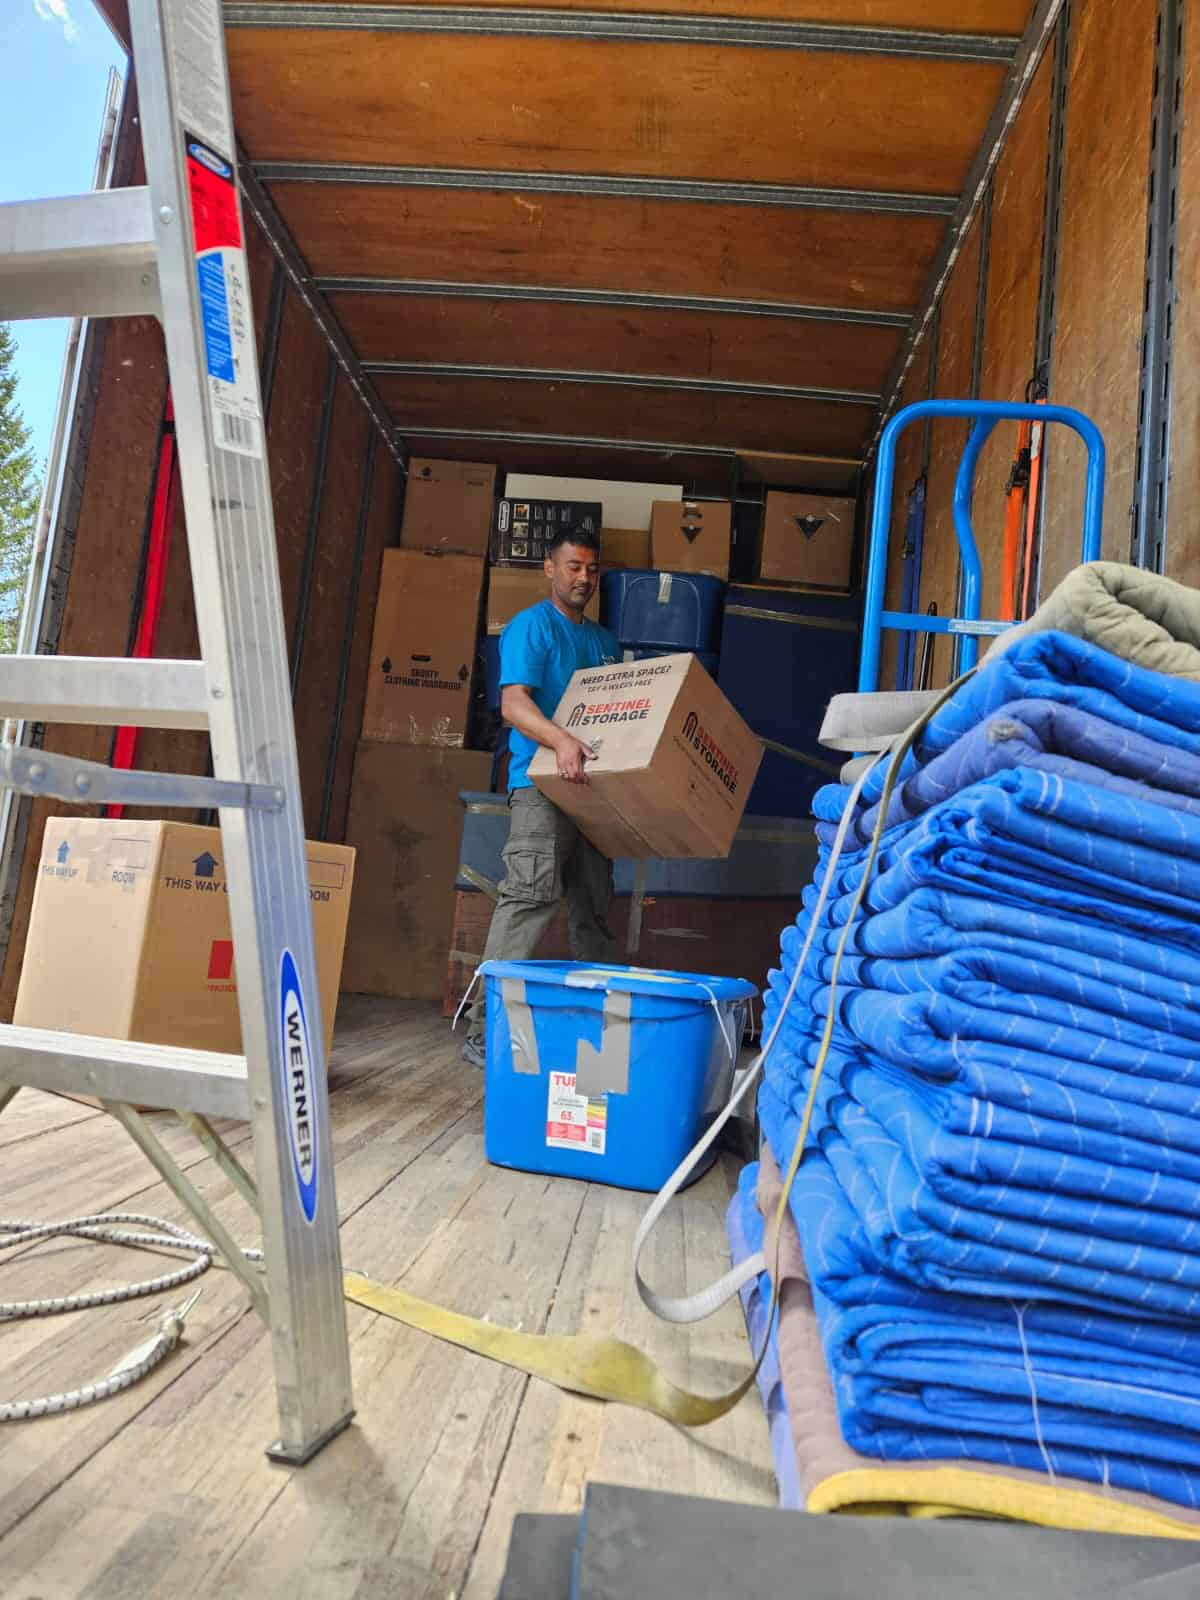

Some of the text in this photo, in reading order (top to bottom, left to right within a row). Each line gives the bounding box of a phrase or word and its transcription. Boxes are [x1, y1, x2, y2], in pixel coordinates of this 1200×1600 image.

[581, 665, 672, 686] NEED EXTRA SPACE?
[586, 698, 652, 714] SENTINEL
[581, 709, 649, 726] STORAGE
[697, 725, 738, 781] SENTINEL
[693, 736, 737, 794] STORAGE
[112, 871, 136, 883] ROOM
[165, 877, 192, 890] THIS
[195, 880, 219, 892] WAY
[287, 1010, 312, 1168] WERNER
